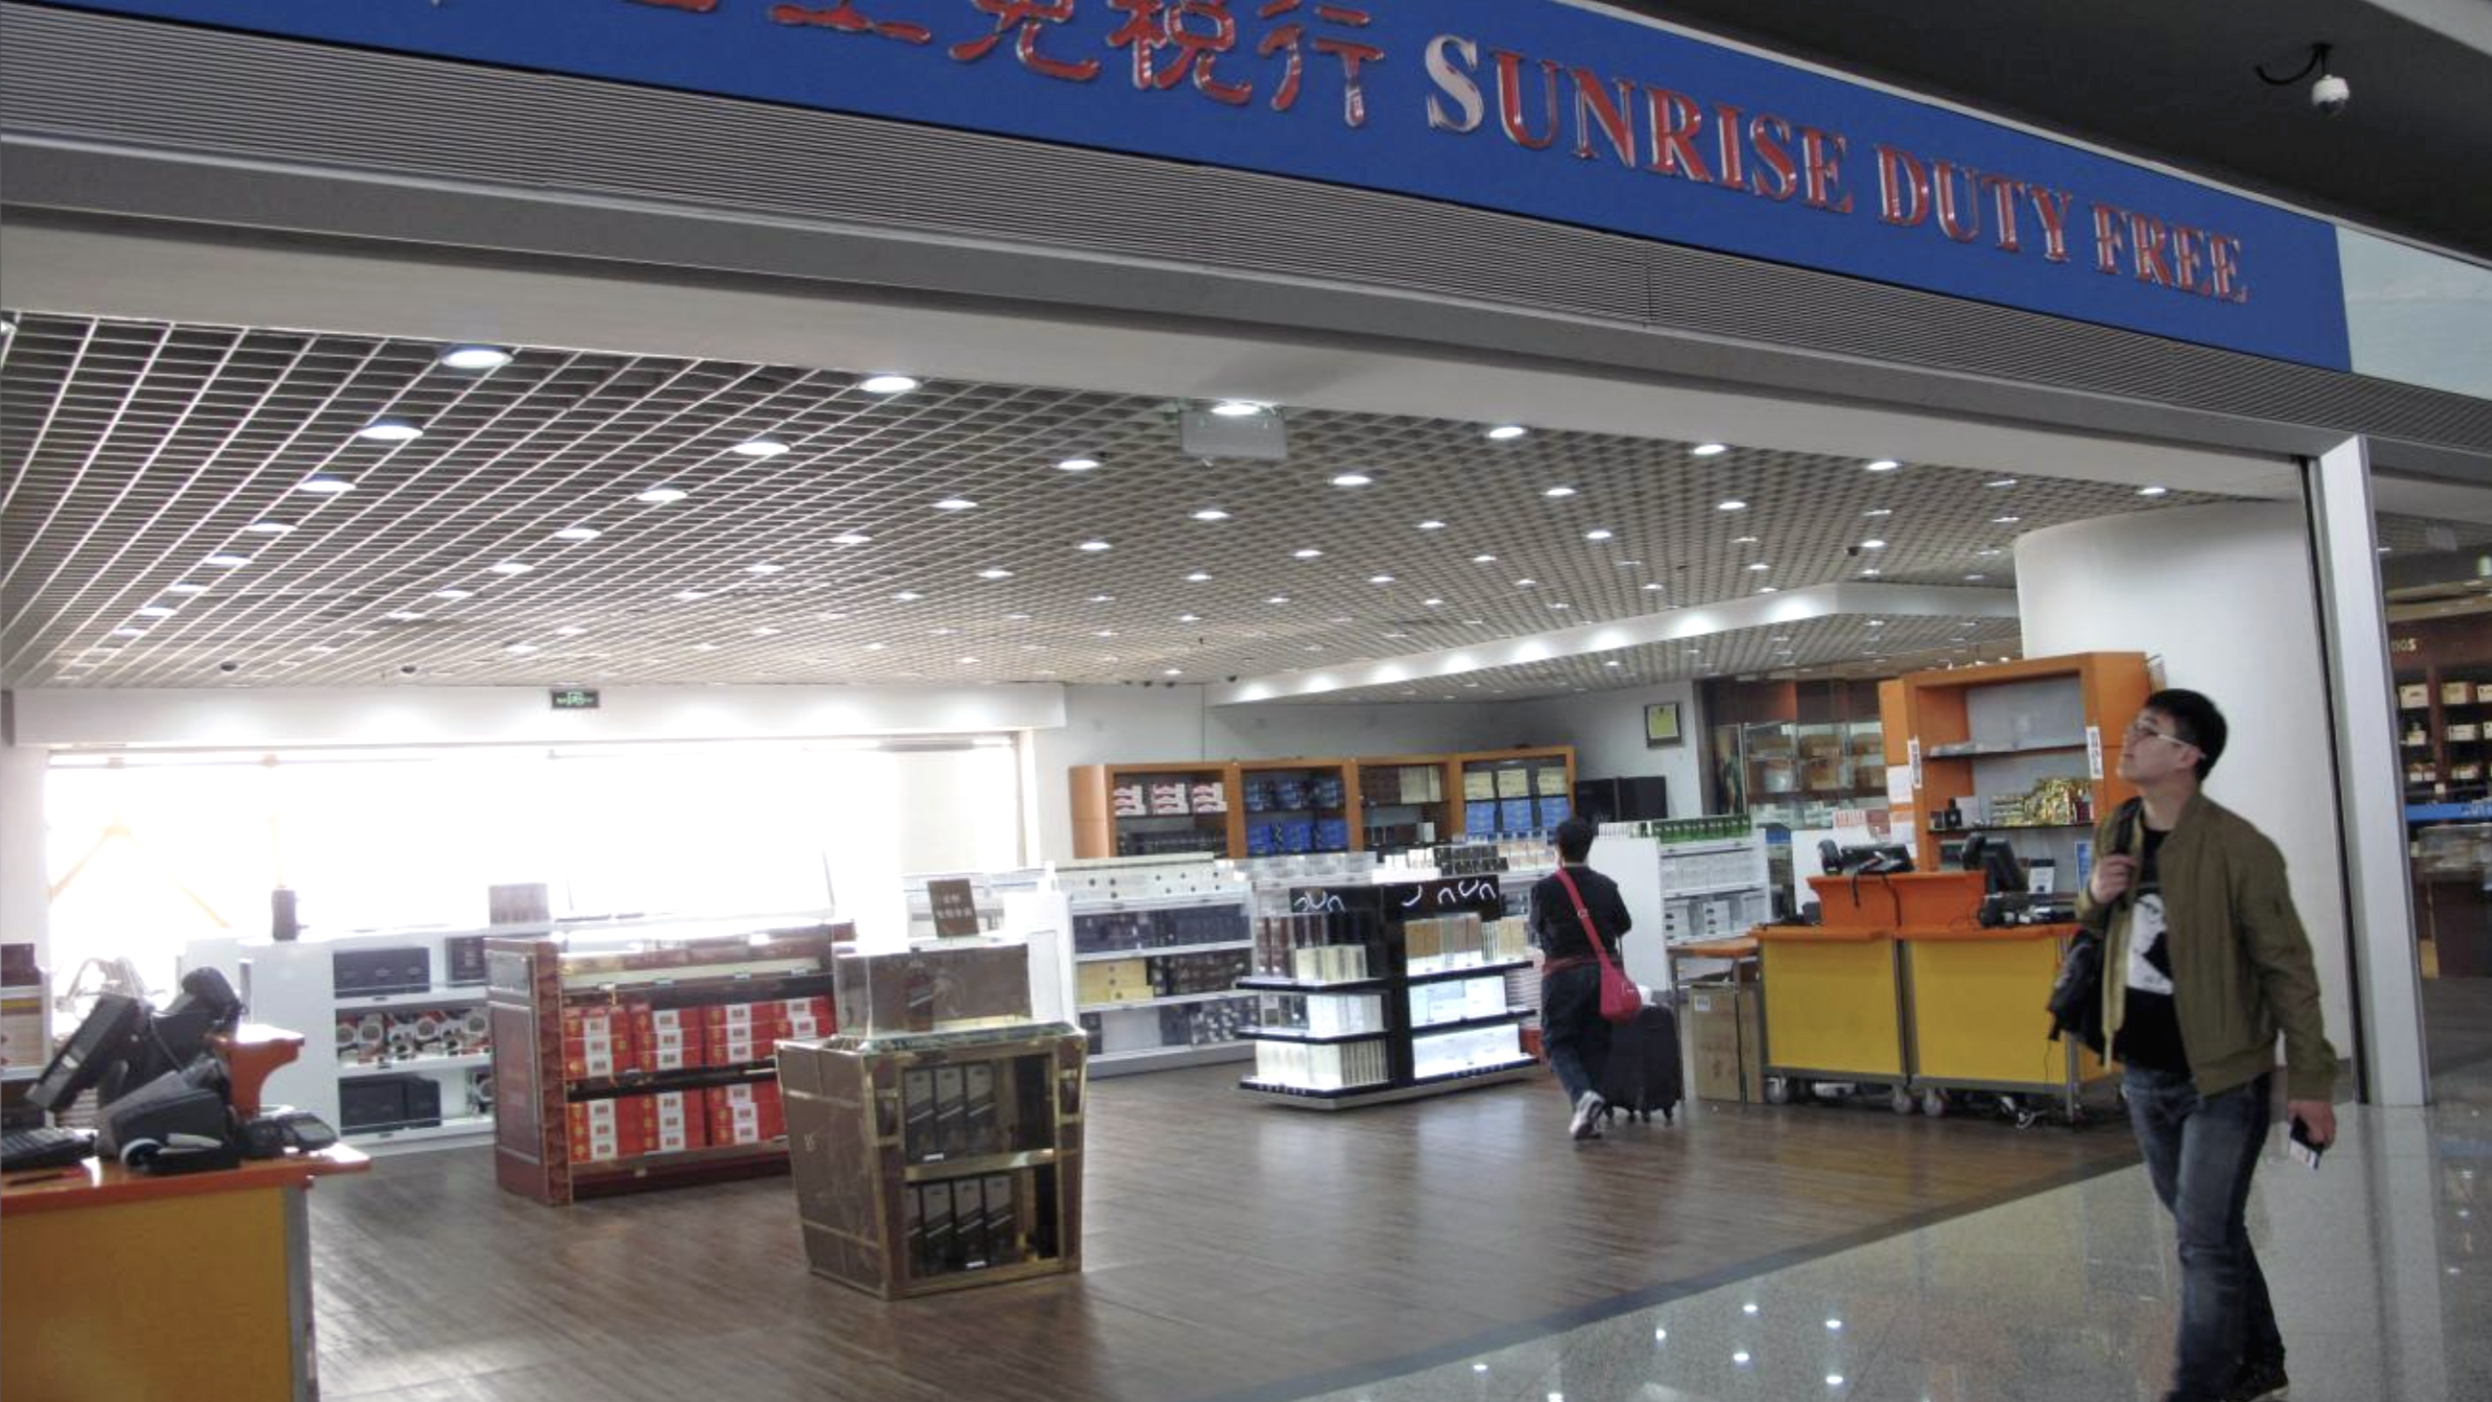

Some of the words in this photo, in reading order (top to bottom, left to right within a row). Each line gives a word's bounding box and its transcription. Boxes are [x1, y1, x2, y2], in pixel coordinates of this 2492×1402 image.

[1425, 35, 1851, 213] SUNRISE
[1877, 144, 2074, 263] DUTY
[2093, 203, 2247, 304] FREE
